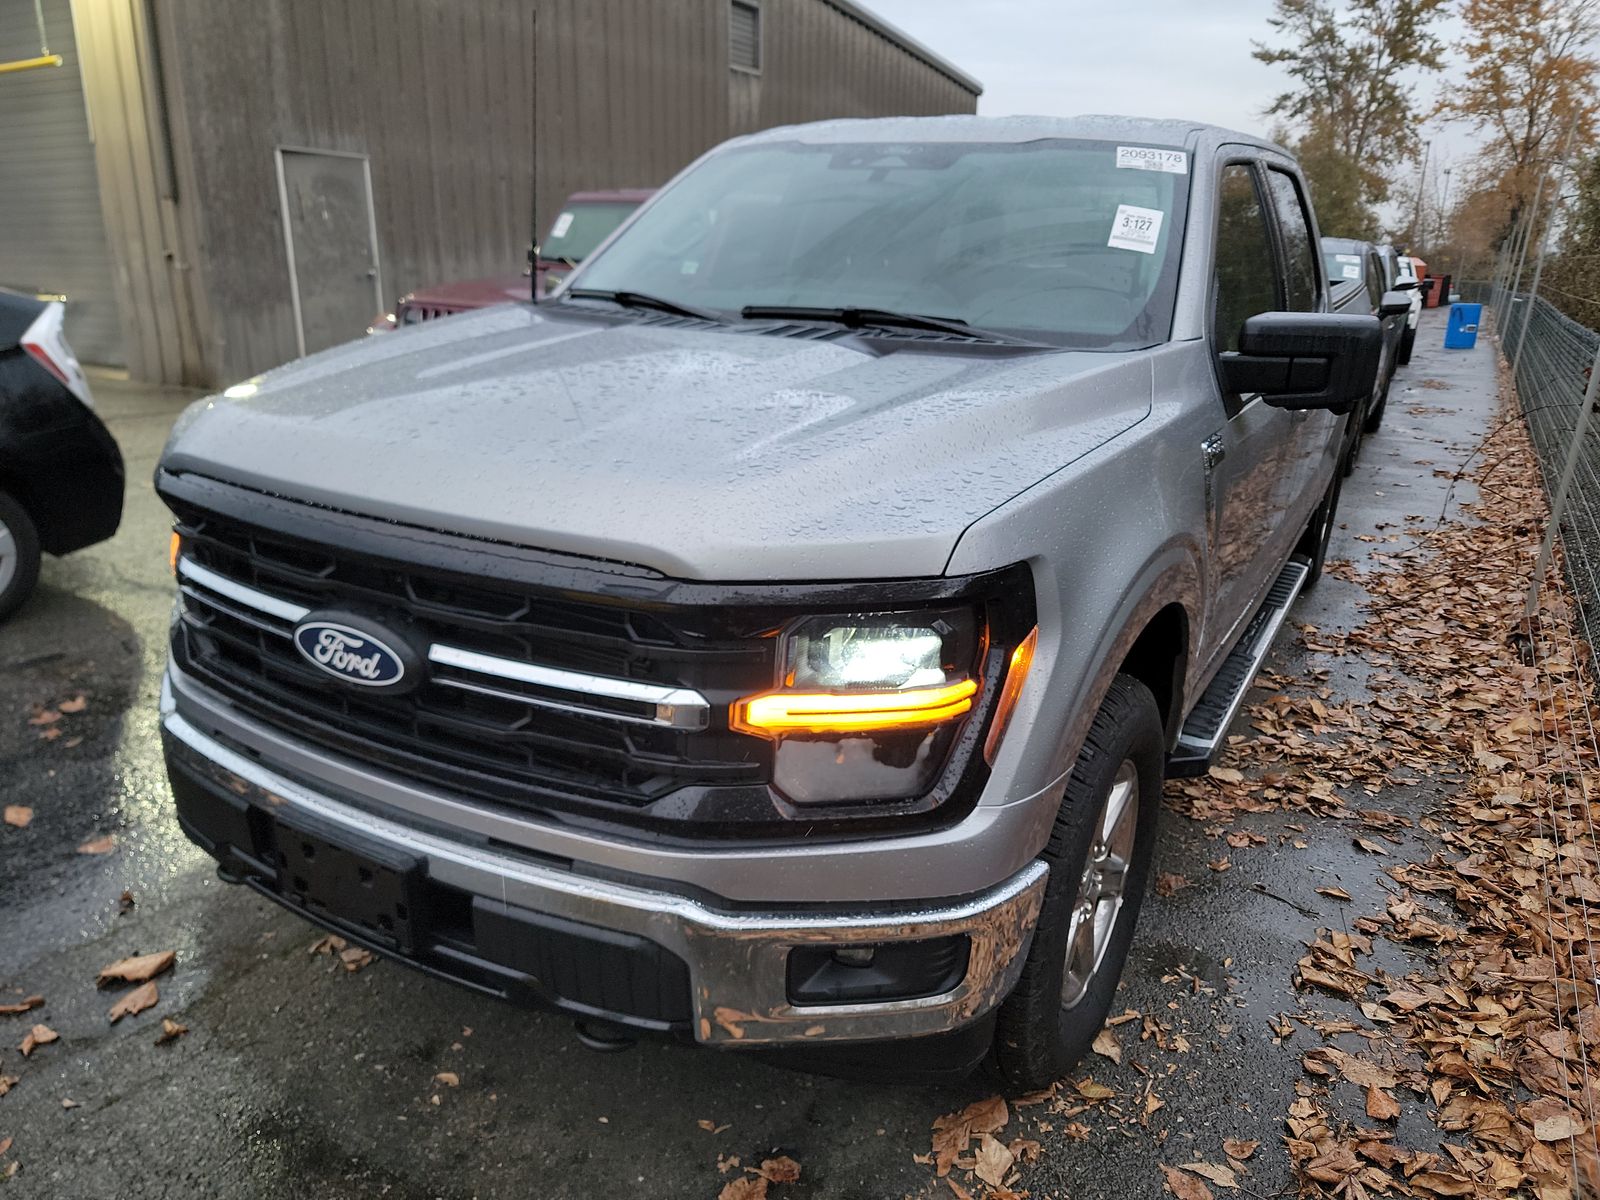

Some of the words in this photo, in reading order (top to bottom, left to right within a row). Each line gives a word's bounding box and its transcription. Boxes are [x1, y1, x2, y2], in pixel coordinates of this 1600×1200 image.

[1120, 149, 1183, 163] 2093178
[1122, 217, 1153, 231] 3:127
[313, 629, 382, 679] Ford
